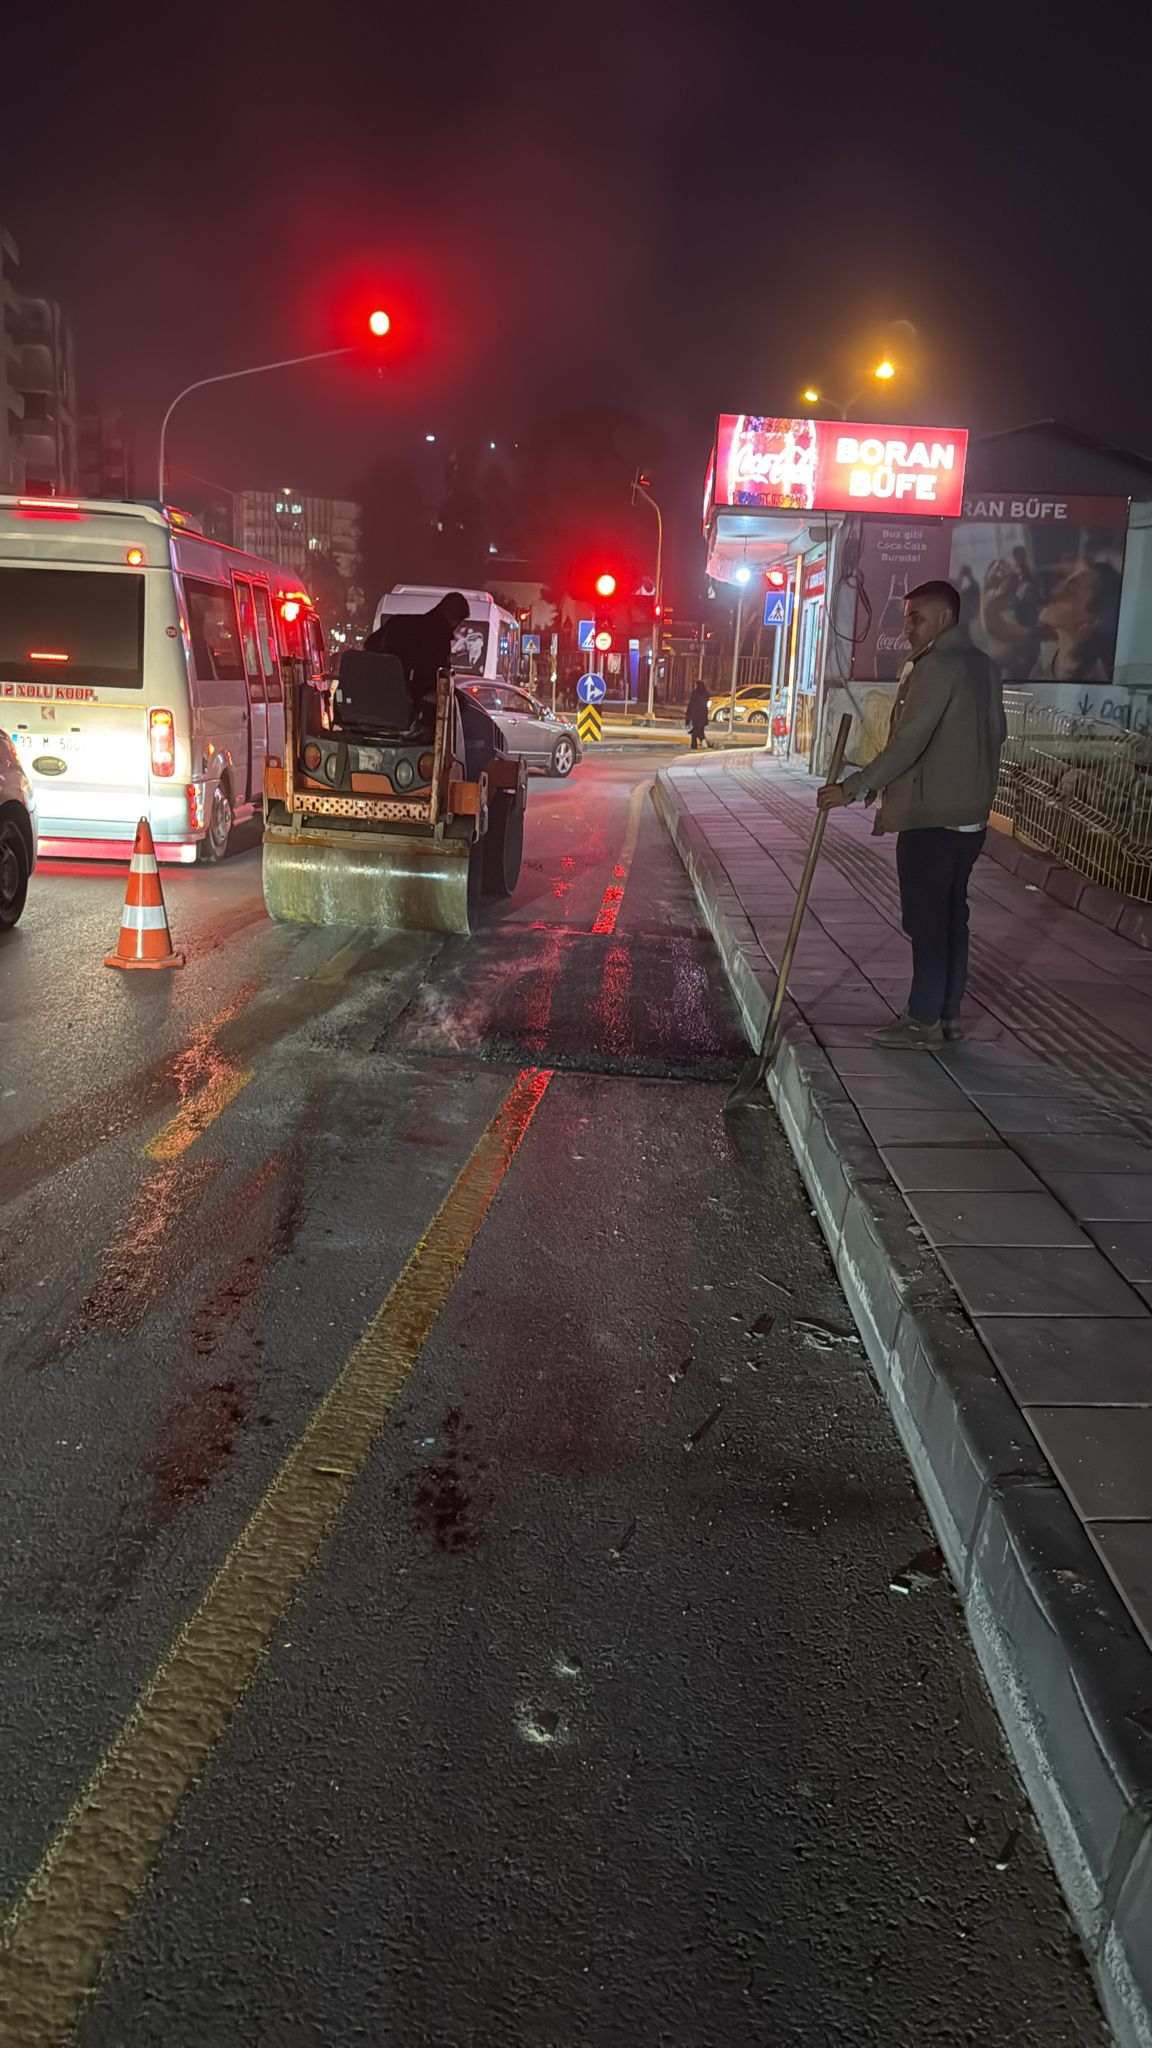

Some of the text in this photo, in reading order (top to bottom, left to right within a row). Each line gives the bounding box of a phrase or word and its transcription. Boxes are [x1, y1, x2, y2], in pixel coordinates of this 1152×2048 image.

[836, 437, 955, 470] BORAN
[848, 465, 938, 500] BÜFE
[963, 498, 1067, 519] RAN BÜFE
